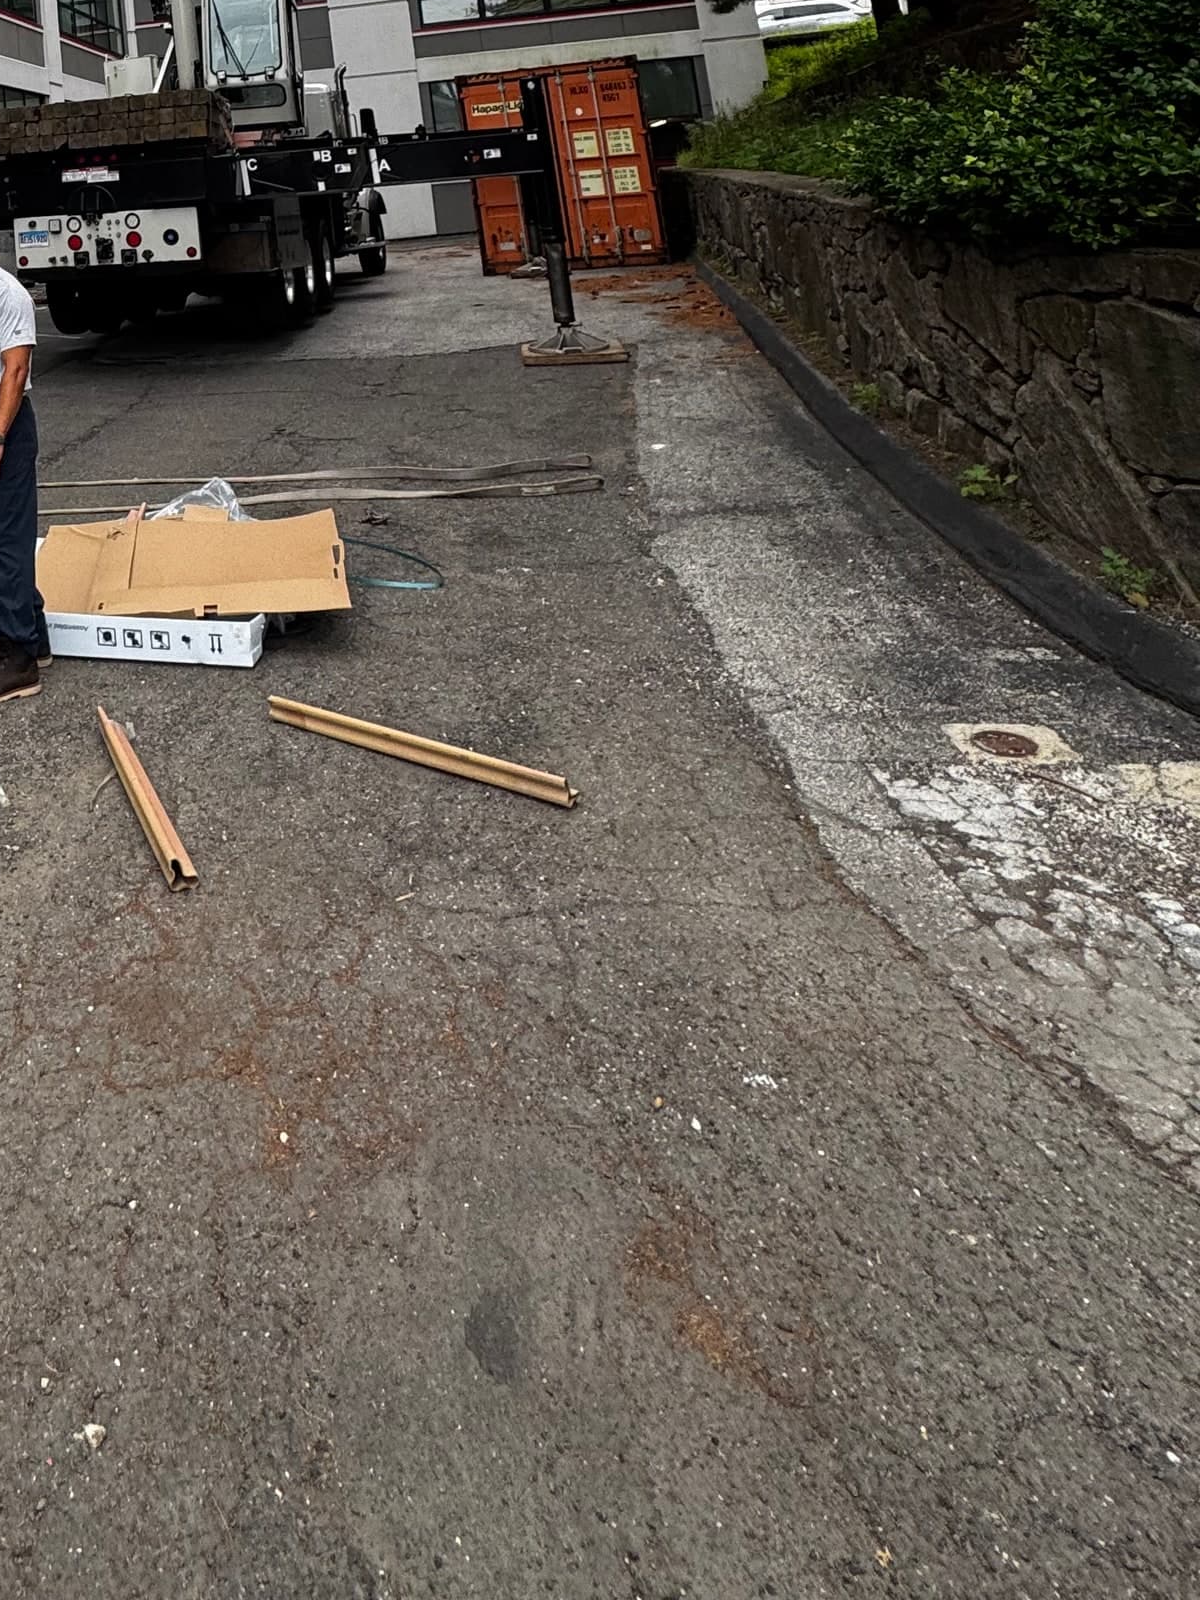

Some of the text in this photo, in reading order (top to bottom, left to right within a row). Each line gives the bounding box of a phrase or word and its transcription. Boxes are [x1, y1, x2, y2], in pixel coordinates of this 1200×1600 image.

[321, 150, 332, 162] B
[247, 158, 258, 171] C
[379, 158, 391, 172] A
